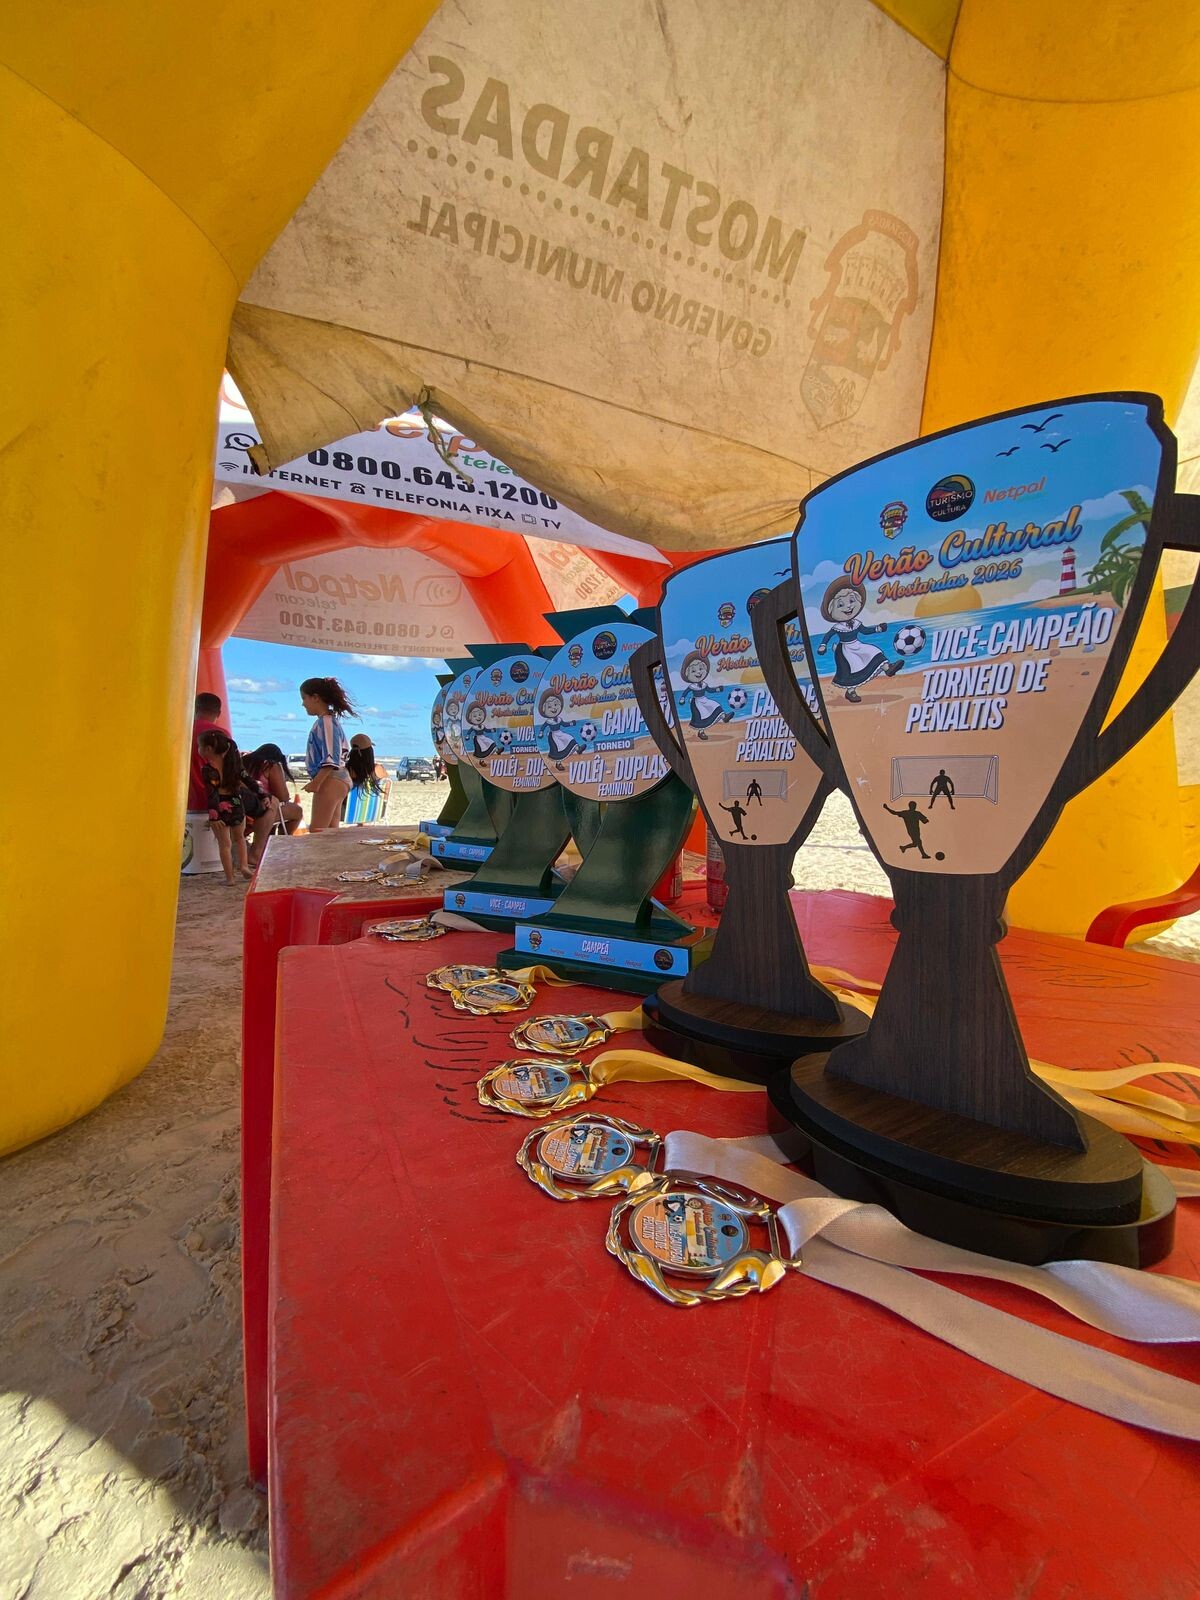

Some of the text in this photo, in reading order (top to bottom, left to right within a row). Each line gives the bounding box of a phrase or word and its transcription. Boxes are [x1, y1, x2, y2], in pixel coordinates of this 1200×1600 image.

[929, 490, 973, 508] TURISMO
[983, 476, 1046, 505] Netpal
[373, 487, 471, 513] TELEFONIA
[475, 505, 516, 521] FIXA
[541, 517, 562, 529] TV
[932, 504, 967, 518] CULTURA
[843, 505, 1083, 587] Verão Cultural
[877, 558, 1024, 603] Mostardas 2026
[930, 602, 1115, 662] VICE-CAMPEÃO
[695, 634, 752, 659] Verão
[550, 672, 598, 696] Verão
[921, 658, 1052, 701] TORNEIO DE
[475, 689, 515, 707] Verão
[745, 718, 797, 741] TORNE
[596, 740, 631, 751] TORNEIO
[614, 754, 668, 782] DUPLAS
[512, 776, 541, 788] FEMININO
[598, 781, 634, 797] FEMININO
